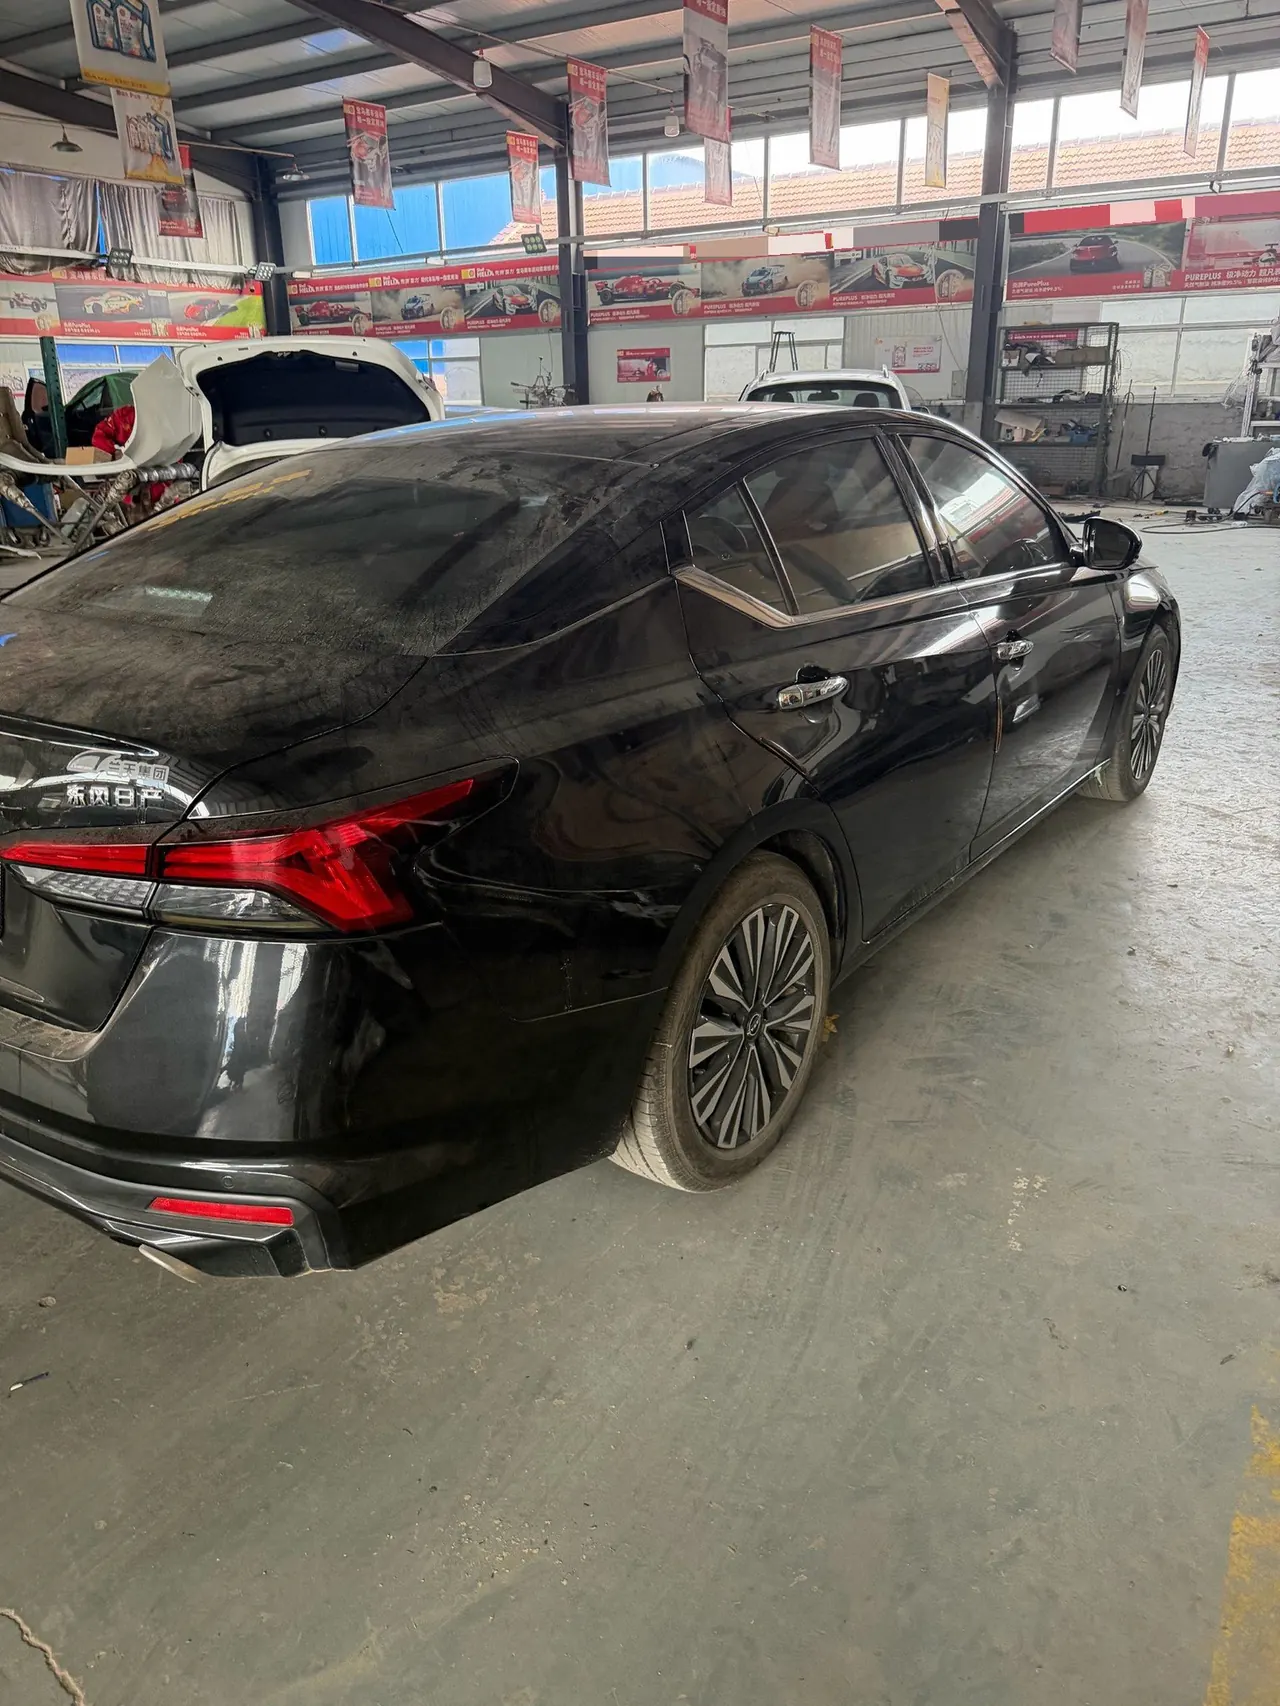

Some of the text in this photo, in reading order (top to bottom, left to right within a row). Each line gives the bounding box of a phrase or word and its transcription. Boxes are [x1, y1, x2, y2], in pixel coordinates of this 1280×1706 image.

[1185, 272, 1221, 281] PUREPLUS
[66, 785, 165, 807] 东风日产
